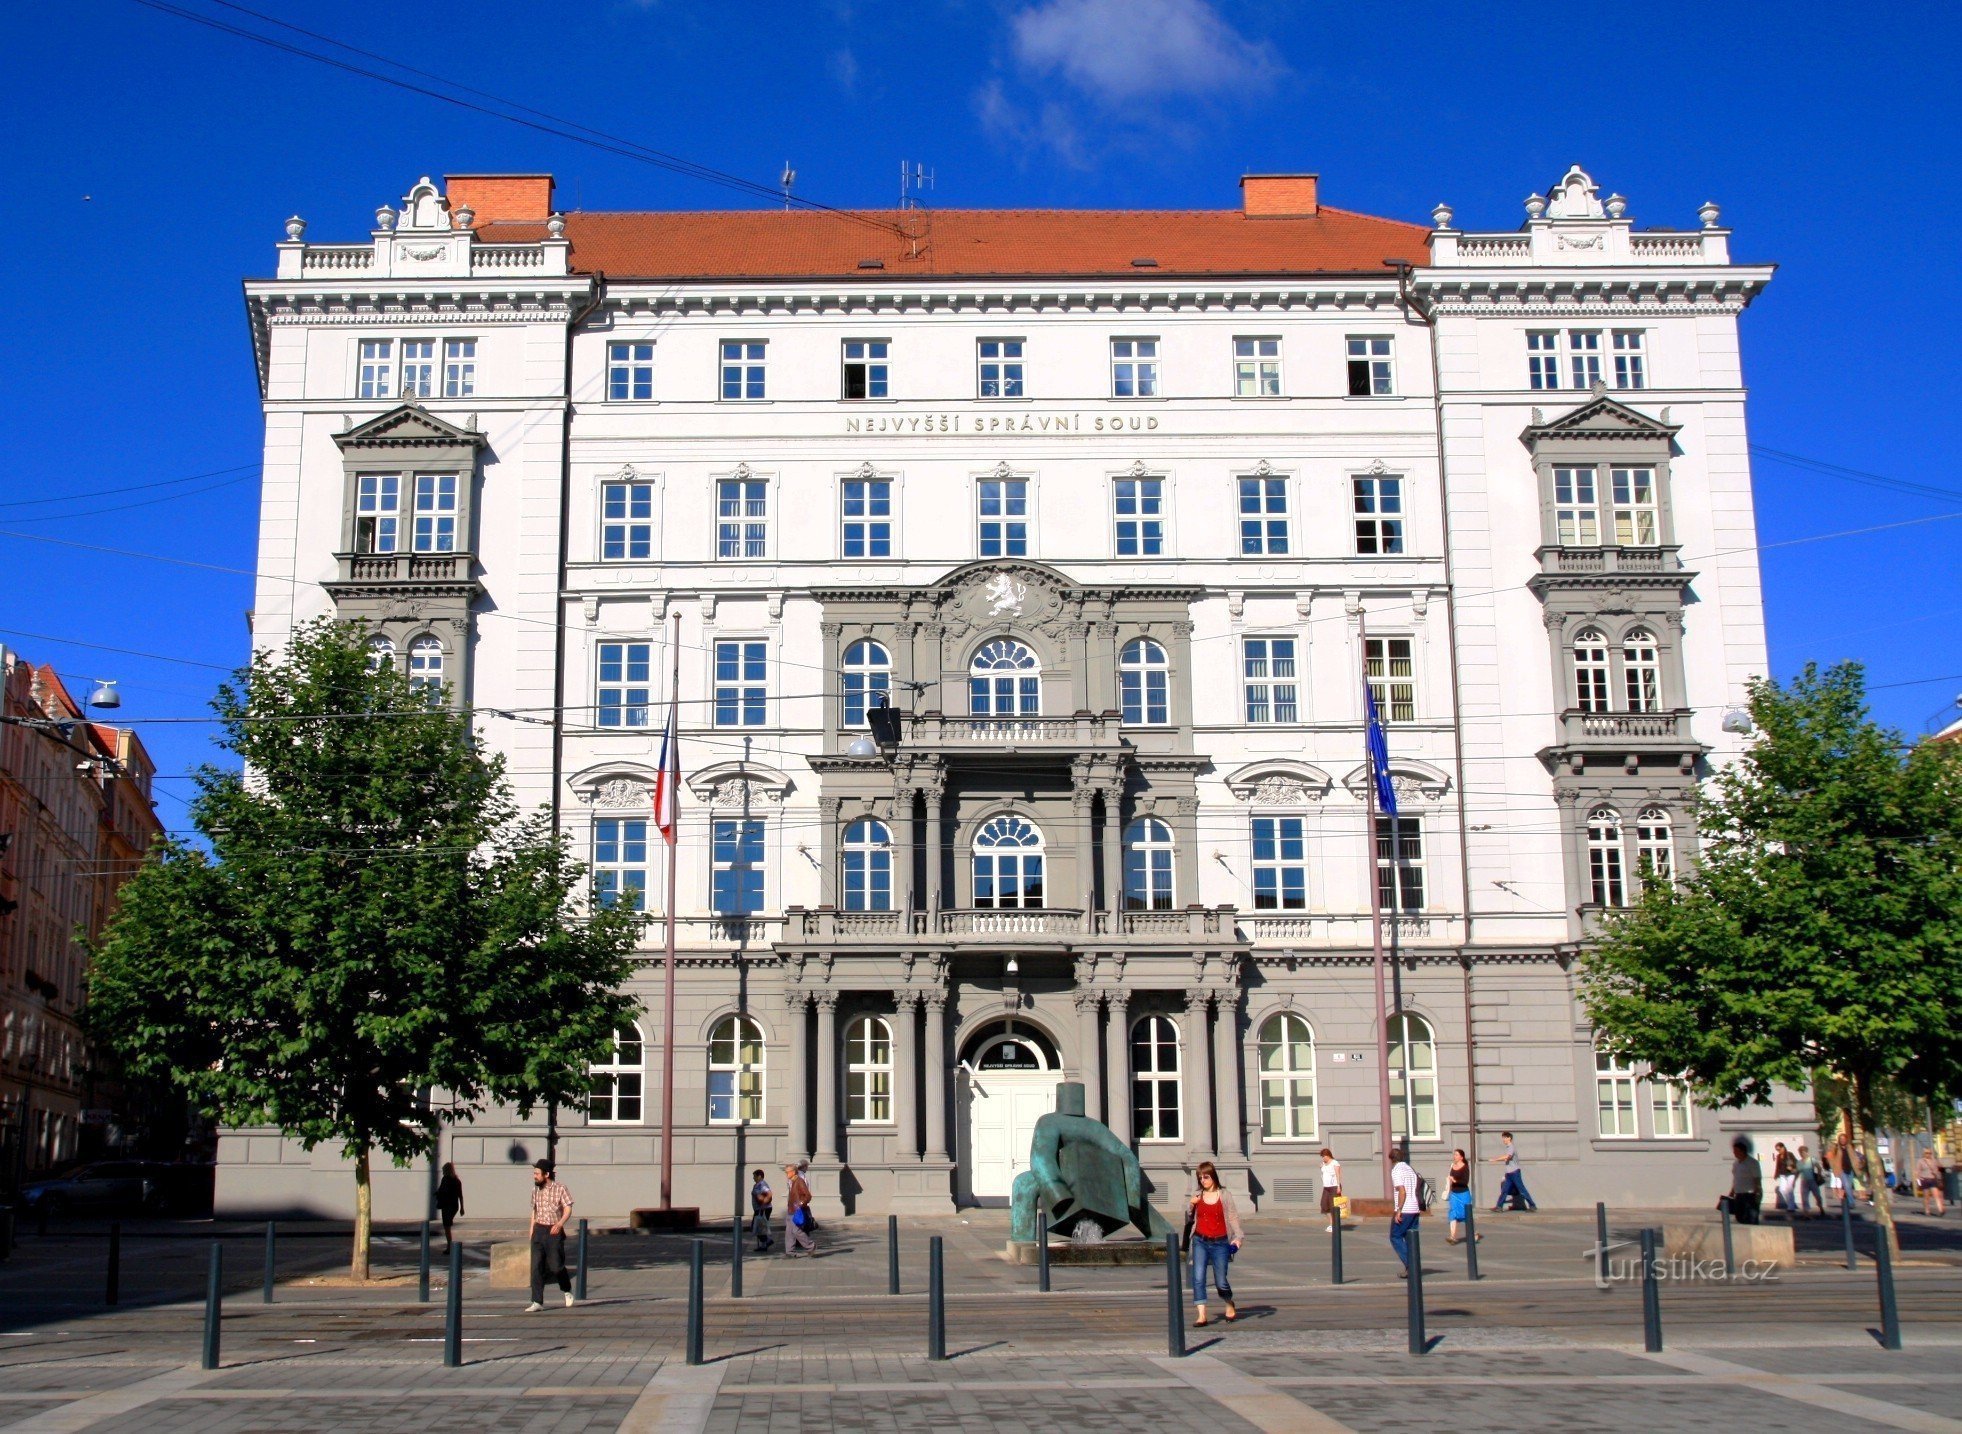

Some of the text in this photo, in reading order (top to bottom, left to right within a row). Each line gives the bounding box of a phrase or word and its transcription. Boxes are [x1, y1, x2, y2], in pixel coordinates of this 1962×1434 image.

[846, 413, 1160, 432] NEJVYŠŠÍ SPRÁVNÍ SOUD
